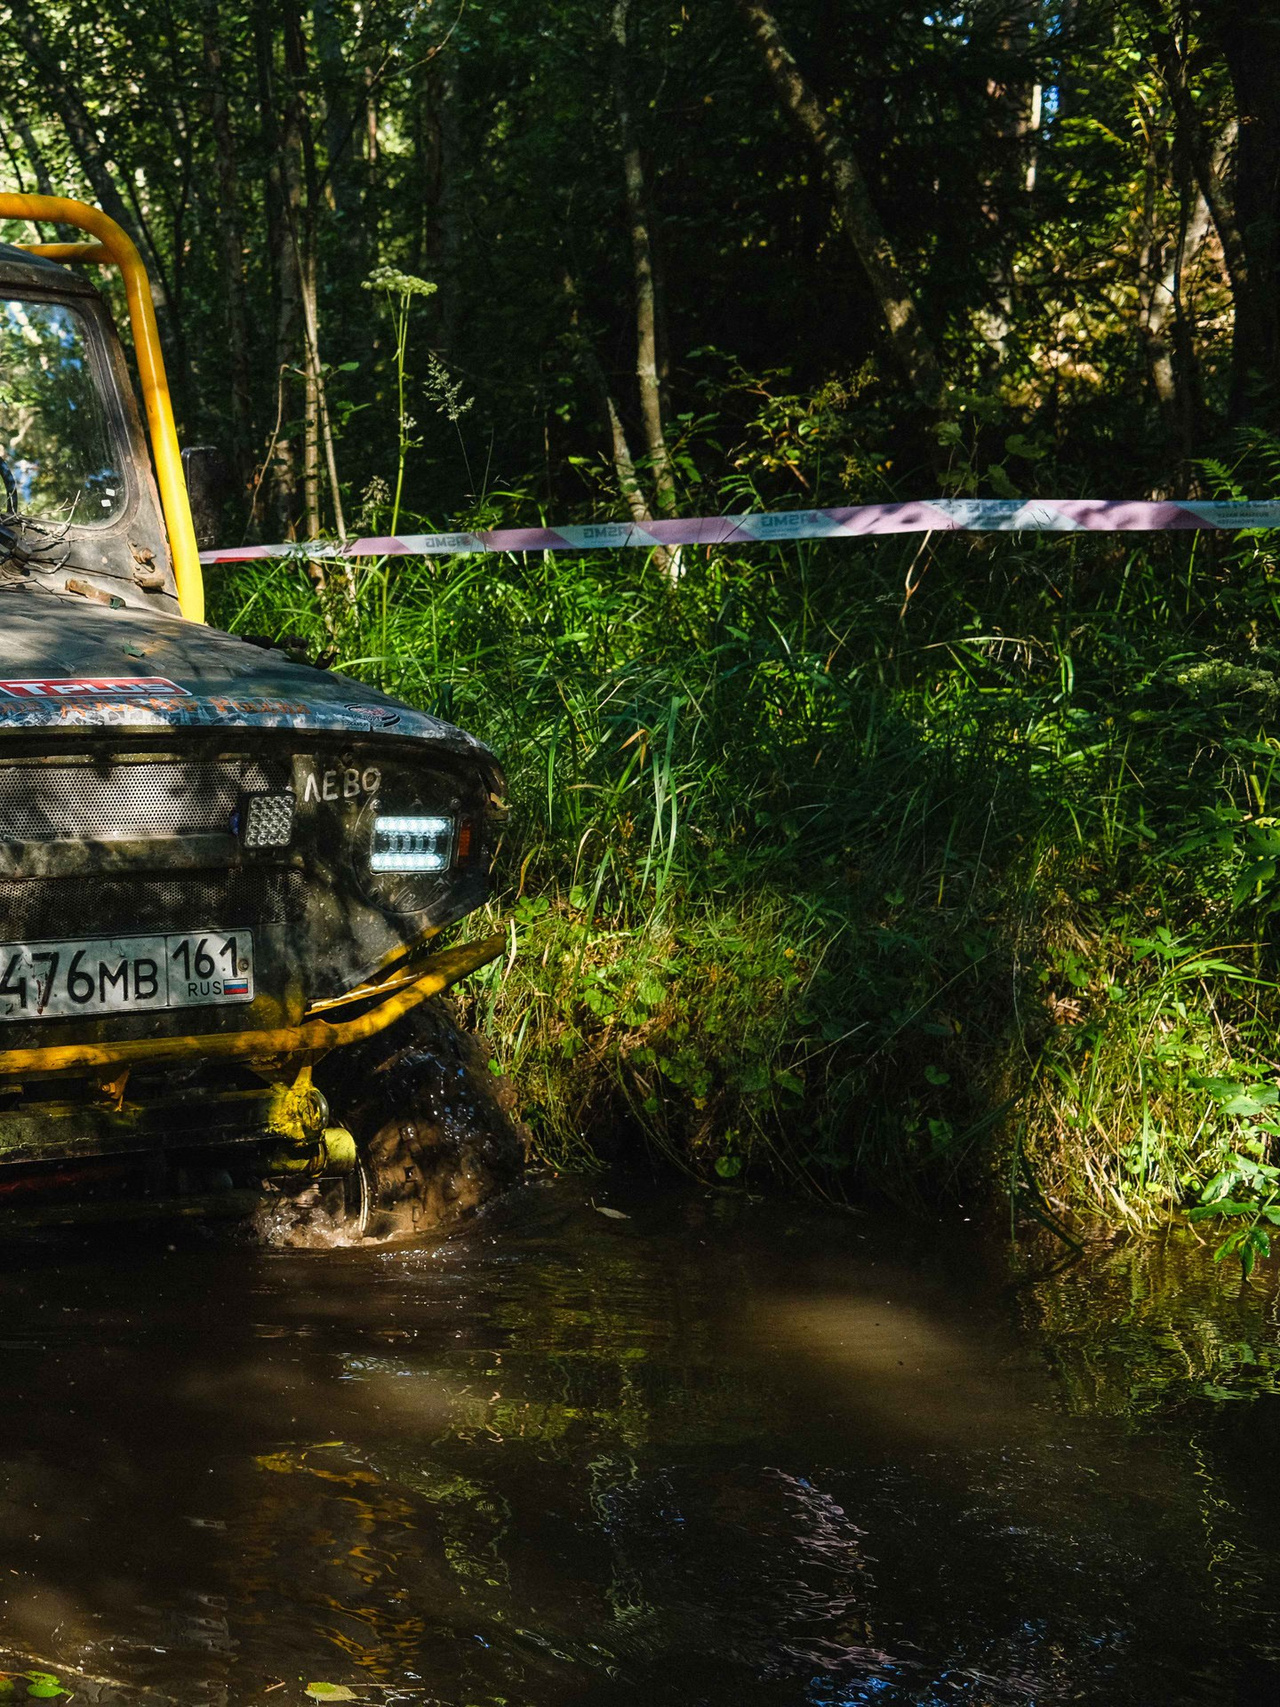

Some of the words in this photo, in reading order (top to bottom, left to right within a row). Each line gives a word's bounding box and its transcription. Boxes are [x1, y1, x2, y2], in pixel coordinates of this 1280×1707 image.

[304, 767, 381, 803] ЛЕВО
[171, 937, 238, 980] 161
[188, 980, 221, 997] RUS
